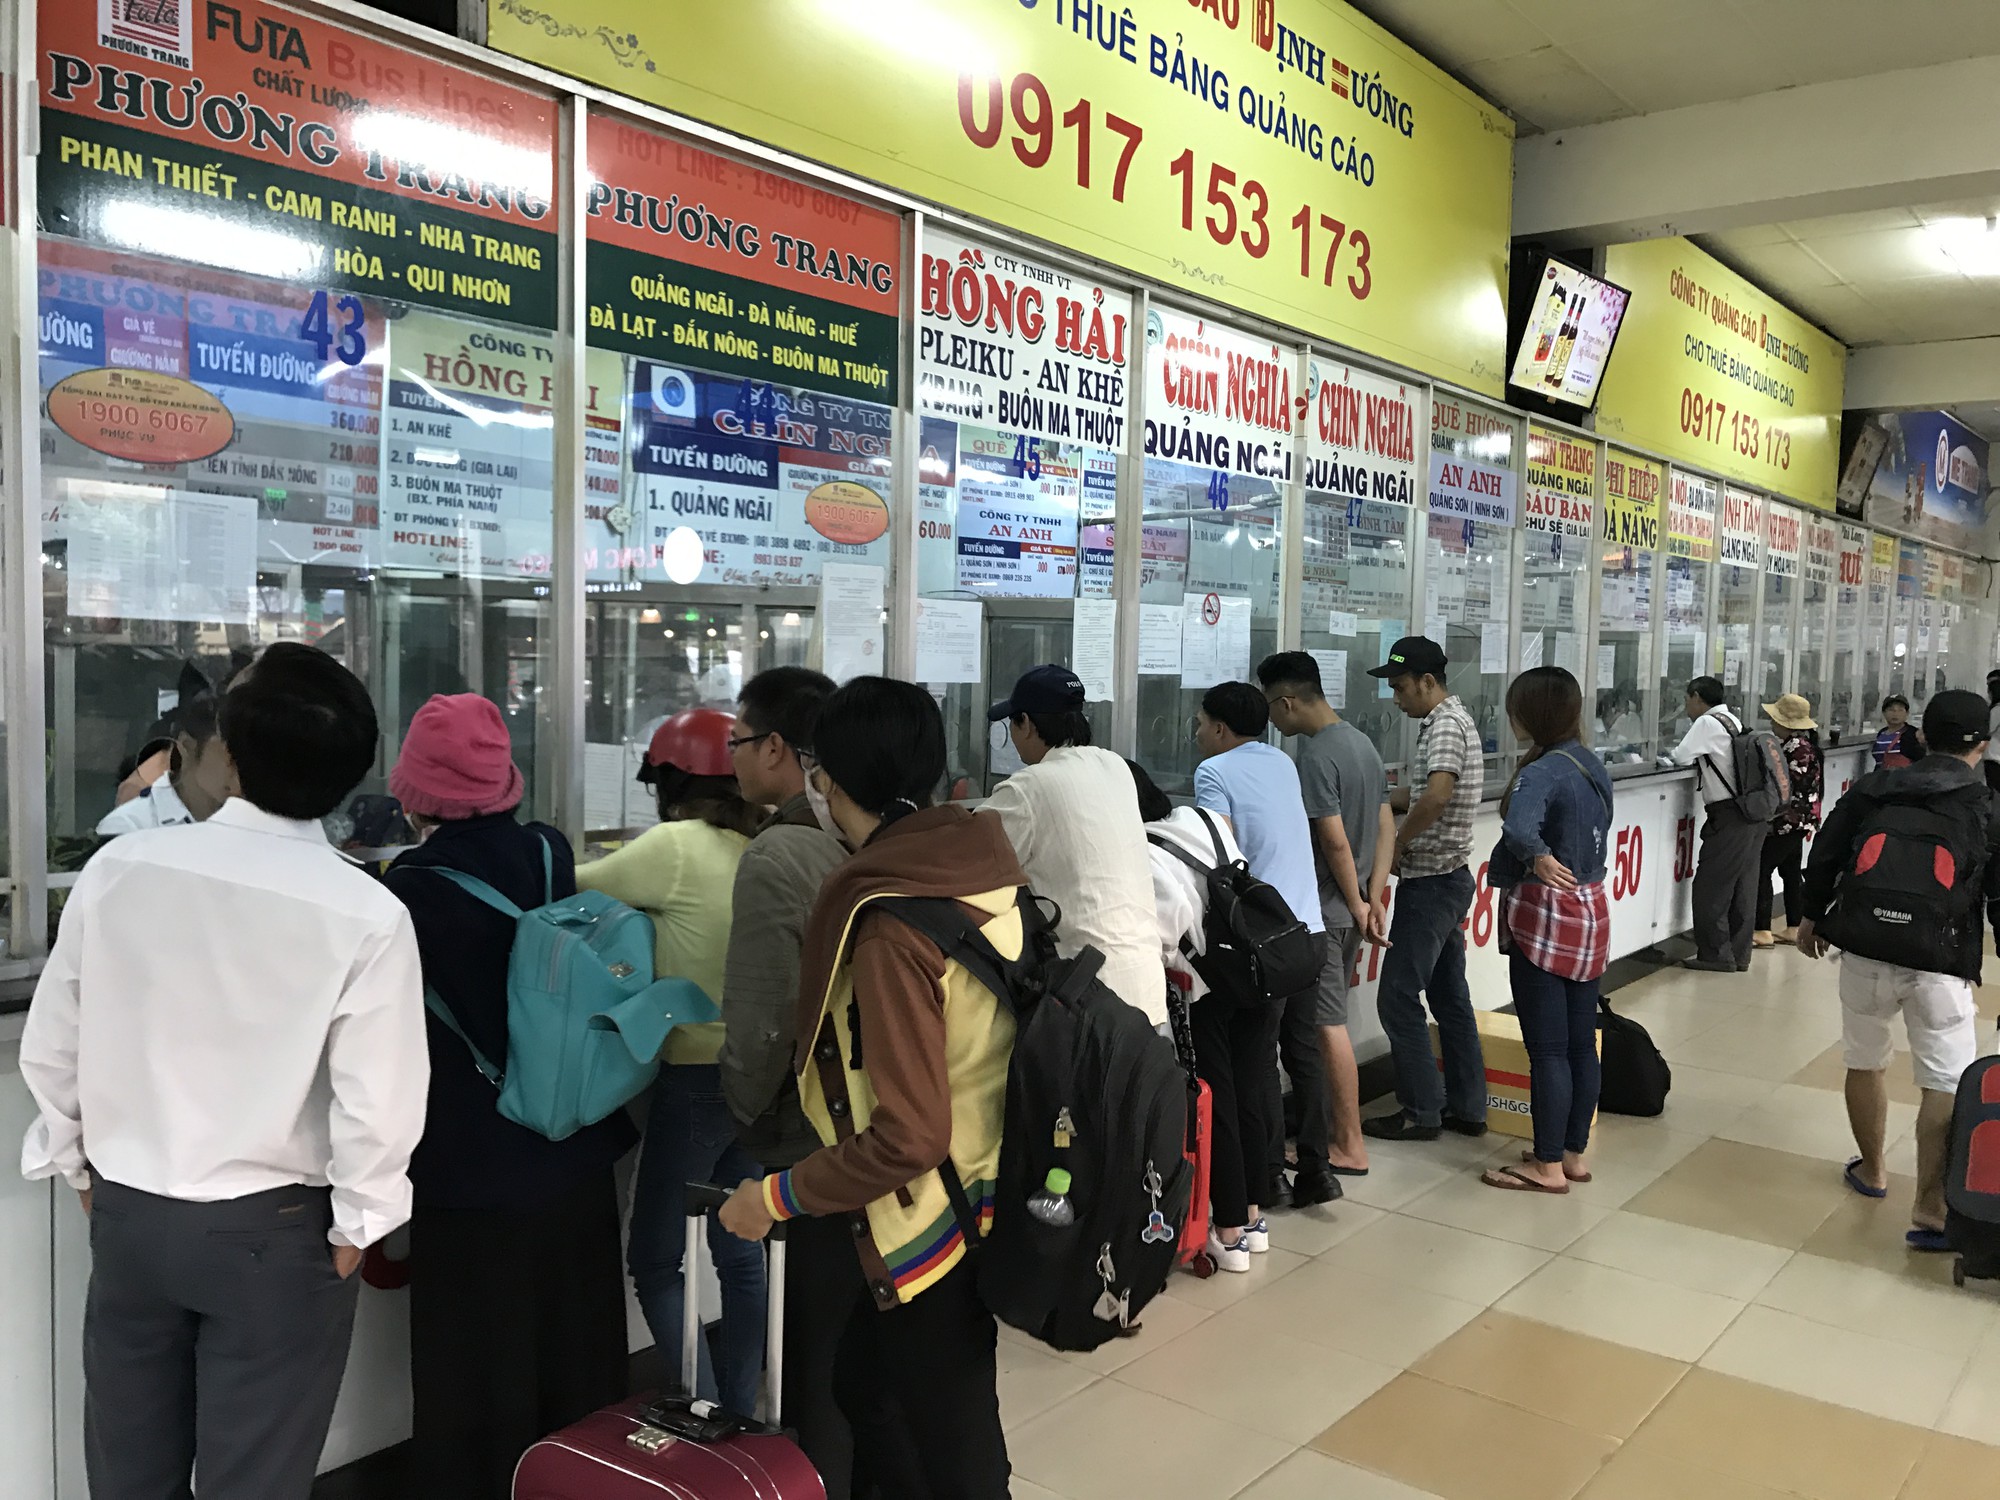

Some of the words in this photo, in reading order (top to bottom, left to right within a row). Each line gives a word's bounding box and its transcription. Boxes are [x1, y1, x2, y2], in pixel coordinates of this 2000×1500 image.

[151, 48, 190, 68] TRANG
[206, 1, 311, 70] FUTA
[253, 67, 305, 98] CHẤT
[1056, 0, 1137, 64] THUÊ
[1150, 32, 1229, 113] BẢNG
[1238, 91, 1323, 161] QUẢNG
[1330, 136, 1375, 188] CÁO
[48, 51, 341, 167] PHƯƠNG
[616, 125, 668, 166] HOT
[676, 144, 728, 187] LINE
[753, 169, 804, 209] 1900
[812, 189, 862, 226] 6067
[957, 64, 1143, 203] 0917
[1169, 148, 1270, 260] 153
[1291, 204, 1372, 301] 173
[61, 136, 143, 180] PHAN
[152, 157, 237, 200] THIẾT
[265, 185, 322, 221] CAM
[331, 200, 396, 238] RANH
[420, 222, 465, 254] NHA
[471, 234, 541, 271] TRANG
[586, 182, 761, 257] PHƯƠNG
[771, 231, 893, 294] TRANG
[334, 246, 384, 281] HÒA
[407, 264, 445, 293] QUI
[452, 273, 511, 306] NHƠN
[994, 255, 1018, 274] CTY
[1022, 264, 1054, 285] TNHH
[1057, 275, 1072, 291] VT
[299, 290, 367, 366] 43
[631, 274, 690, 308] QUẢNG
[695, 289, 733, 318] NGÃI
[749, 299, 770, 326] ĐÀ
[776, 304, 815, 338] NẴNG
[829, 321, 859, 347] HUẾ
[921, 249, 1046, 344] HỒNG
[1055, 287, 1127, 367] HẢI
[1670, 266, 1696, 309] CÔNG
[1698, 285, 1710, 315] TY
[1711, 294, 1740, 335] QUẢNG
[1741, 310, 1756, 344] CÁO
[197, 340, 255, 375] TUYẾN
[260, 351, 317, 386] ĐƯỜNG
[470, 333, 526, 359] CÔNG
[590, 303, 616, 331] ĐÀ
[622, 312, 656, 340] LẠT
[673, 318, 709, 350] ĐẮK
[714, 330, 758, 360] NÔNG
[772, 345, 813, 372] BUÔN
[818, 357, 840, 379] MA
[844, 360, 888, 389] THUỘT
[920, 326, 1014, 381] PLEIKU
[1037, 359, 1070, 395] AN
[1077, 367, 1124, 408] KHÊ
[1684, 333, 1705, 363] CHO
[1706, 344, 1728, 374] THUÊ
[1729, 358, 1751, 387] BẢNG
[1752, 366, 1779, 400] QUẢNG
[1779, 382, 1795, 408] CÁO
[424, 345, 527, 397] HỒNG
[1163, 320, 1221, 416] CHÍN
[1225, 345, 1292, 435] NGHĨA
[77, 401, 140, 426] 1900
[150, 410, 208, 434] 6067
[407, 421, 424, 436] AN
[998, 387, 1043, 433] BUÔN
[1048, 400, 1070, 438] MA
[1075, 406, 1124, 452] THUỘT
[1318, 368, 1361, 449] CHÍN
[1364, 385, 1415, 463] NGHĨA
[1680, 387, 1726, 446] 0917
[1731, 410, 1760, 460] 153
[1765, 425, 1791, 472] 173
[649, 445, 708, 470] TUYẾN
[712, 453, 768, 477] ĐƯỜNG
[1013, 434, 1040, 481] 45
[1144, 416, 1230, 469] QUẢNG
[1236, 440, 1292, 481] NGÃI
[1560, 442, 1593, 476] TRANG
[443, 481, 462, 496] MA
[1208, 471, 1229, 511] 46
[1305, 452, 1368, 497] QUẢNG
[1372, 466, 1415, 505] NGÃI
[1429, 489, 1454, 510] QUẢNG
[1455, 497, 1469, 513] SƠN
[1439, 463, 1463, 488] AN
[1467, 470, 1502, 498] ANH
[1566, 477, 1593, 497] NGÃI
[1628, 463, 1659, 504] HIỆP
[671, 485, 728, 517] QUẢNG
[734, 495, 772, 522] NGÃI
[818, 505, 844, 520] 1900
[849, 509, 877, 524] 6067
[979, 508, 1011, 521] CÔNG
[1015, 514, 1029, 523] TY
[1033, 516, 1062, 527] TNHH
[1346, 498, 1363, 528] 47
[1560, 497, 1592, 523] BẢN
[988, 524, 1012, 537] AN
[1018, 527, 1053, 541] ANH
[1156, 529, 1178, 538] NAM
[1613, 825, 1643, 901] 50
[1673, 814, 1695, 883] 51
[1882, 910, 1912, 921] YAMAHA
